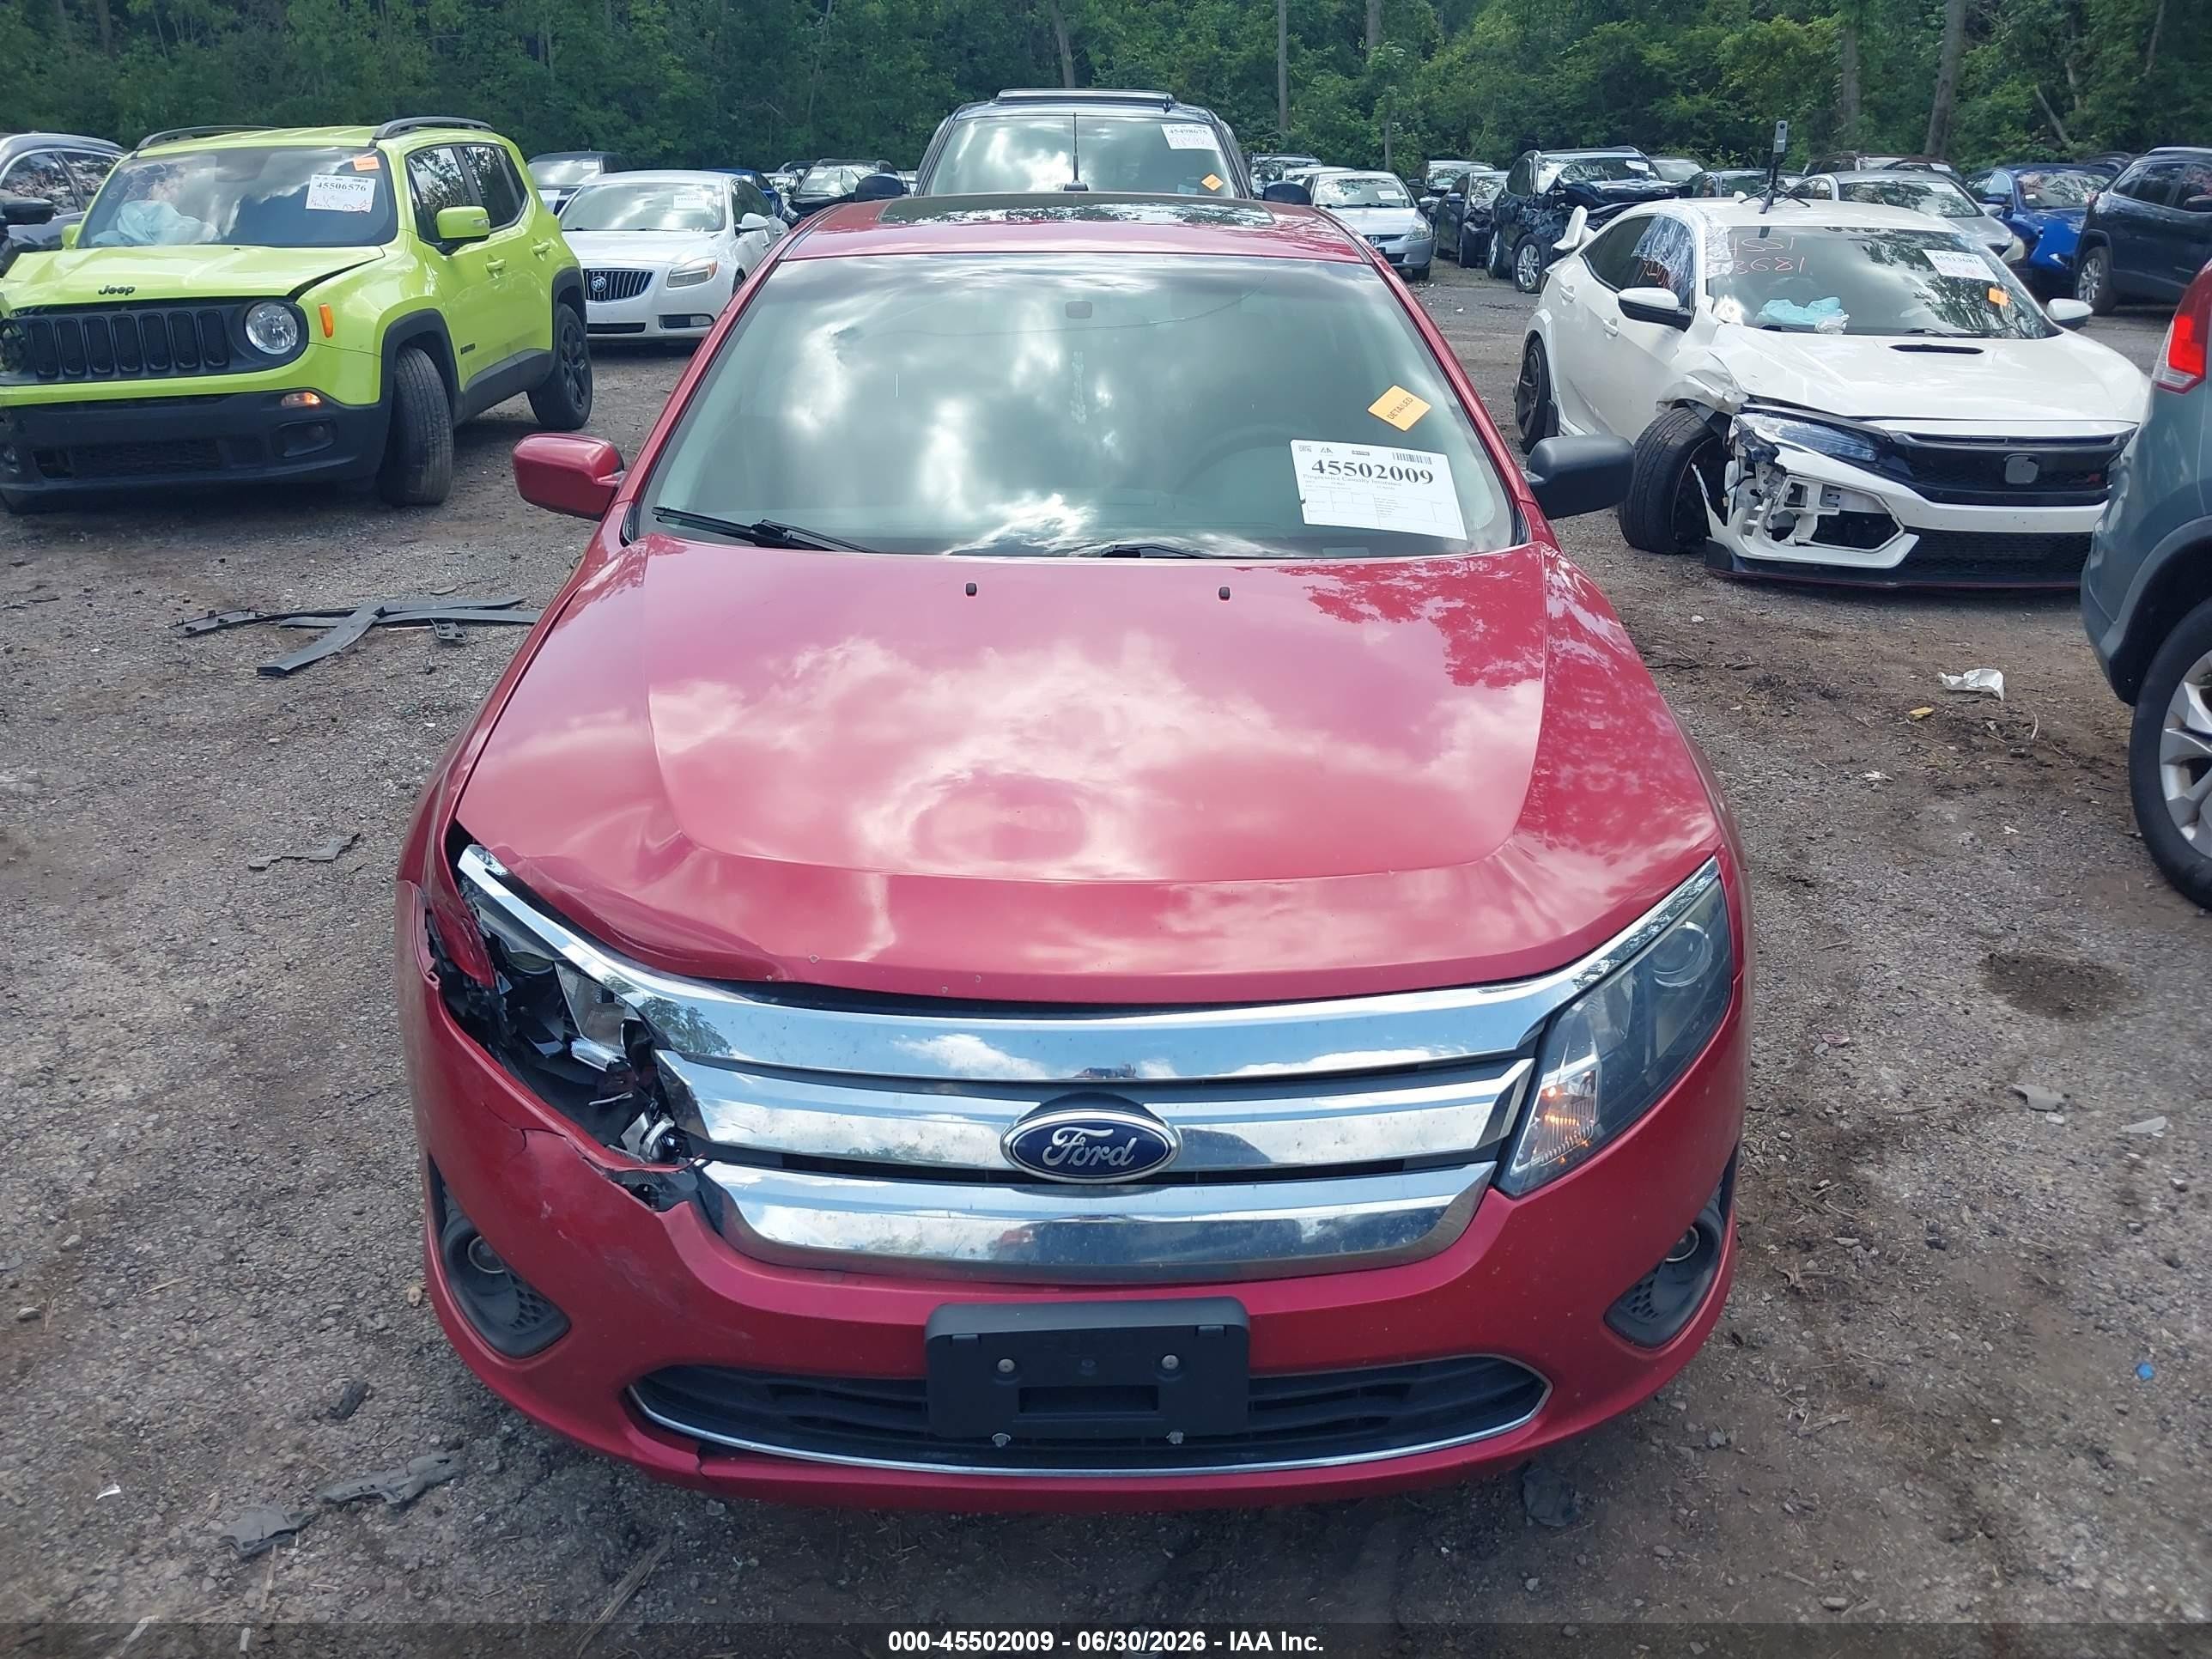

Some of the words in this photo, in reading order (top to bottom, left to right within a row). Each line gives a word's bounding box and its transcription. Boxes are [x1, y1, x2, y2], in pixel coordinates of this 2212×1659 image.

[316, 182, 367, 191] 45506576
[1735, 256, 1805, 275] 3681
[98, 285, 136, 296] Jeep
[1387, 397, 1413, 420] DETAILED
[1311, 459, 1434, 485] 45502009
[1042, 1127, 1138, 1167] Ford
